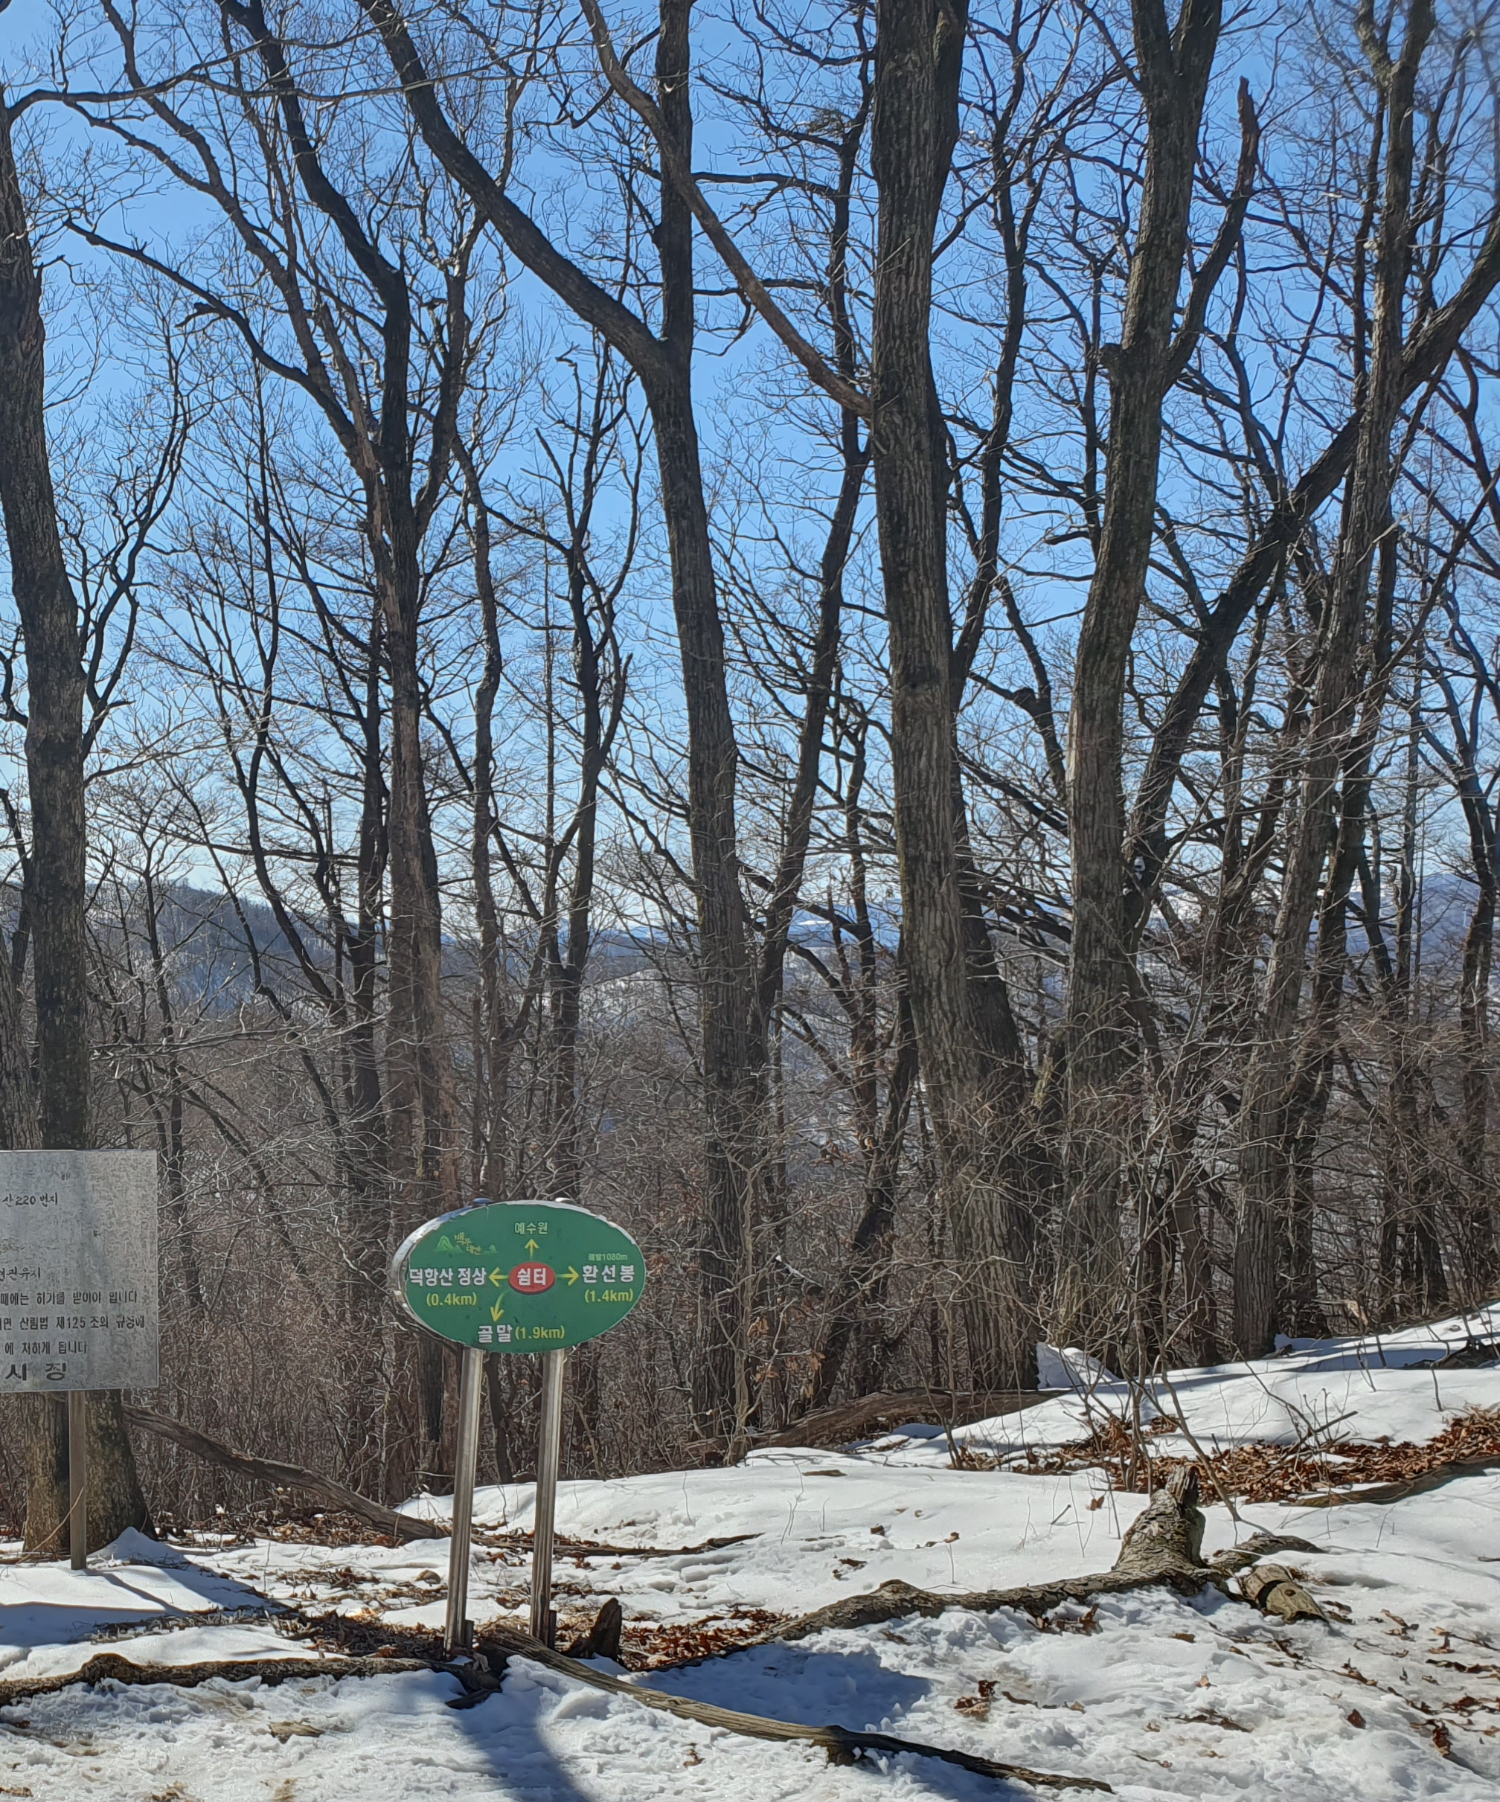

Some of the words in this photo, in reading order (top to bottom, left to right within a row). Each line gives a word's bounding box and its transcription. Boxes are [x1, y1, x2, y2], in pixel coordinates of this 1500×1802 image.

[514, 1221, 548, 1235] 예수원
[409, 1267, 454, 1287] 덕항산
[457, 1267, 487, 1286] 정상
[517, 1267, 547, 1286] 쉼터
[426, 1292, 477, 1307] (0.4km)
[584, 1288, 634, 1304] (1.4km)
[20, 1316, 49, 1331] 산림법
[514, 1326, 566, 1341] (1.9km)
